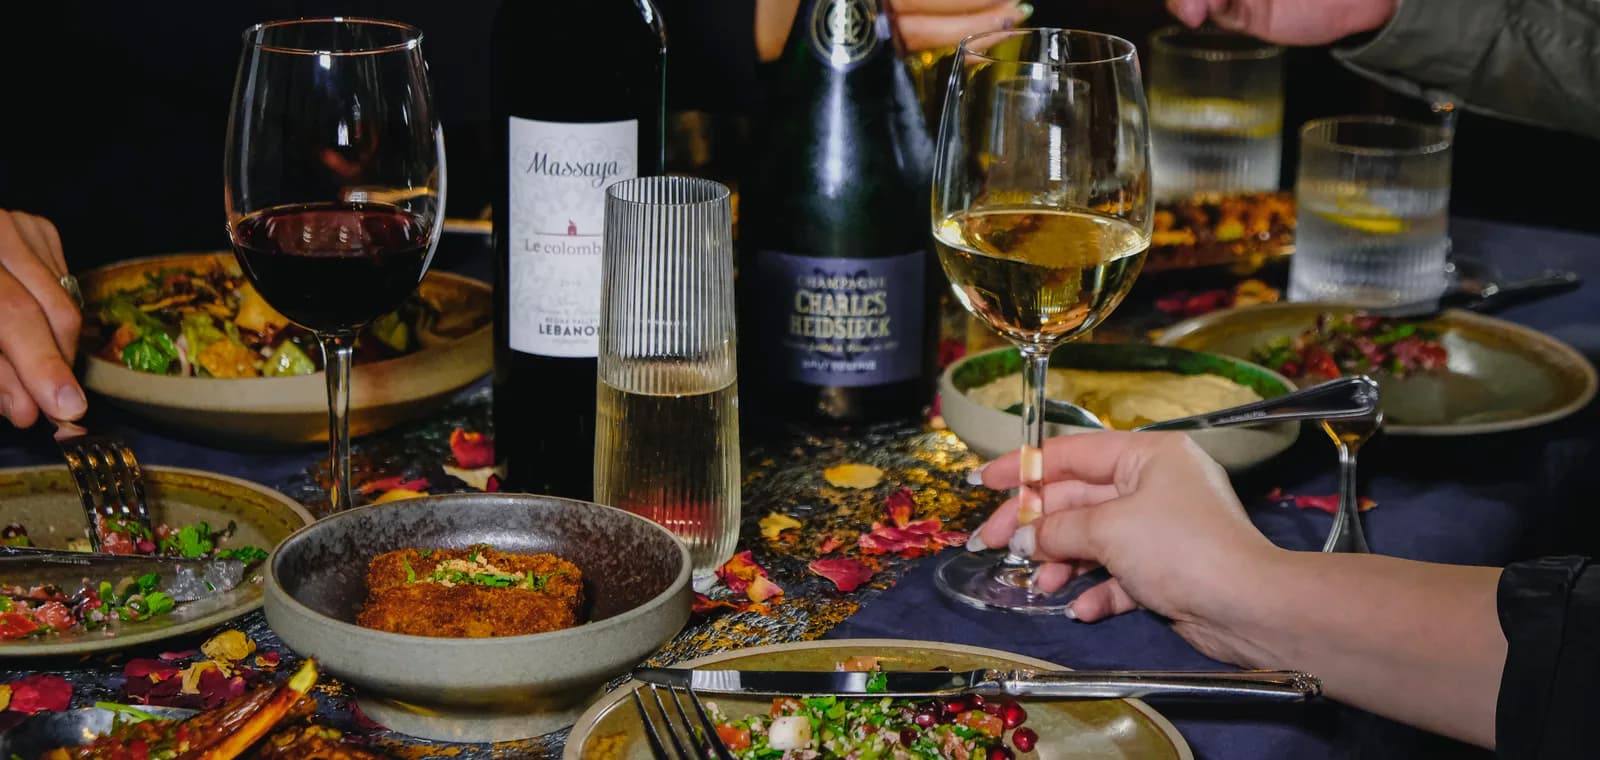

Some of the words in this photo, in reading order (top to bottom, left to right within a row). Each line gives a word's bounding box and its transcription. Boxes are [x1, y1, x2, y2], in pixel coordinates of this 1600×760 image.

[526, 152, 620, 188] Massaya
[525, 238, 541, 253] Le
[797, 276, 887, 289] CHAMPAGNE
[795, 289, 887, 316] CHARLES
[790, 315, 891, 339] HEIDSIECK
